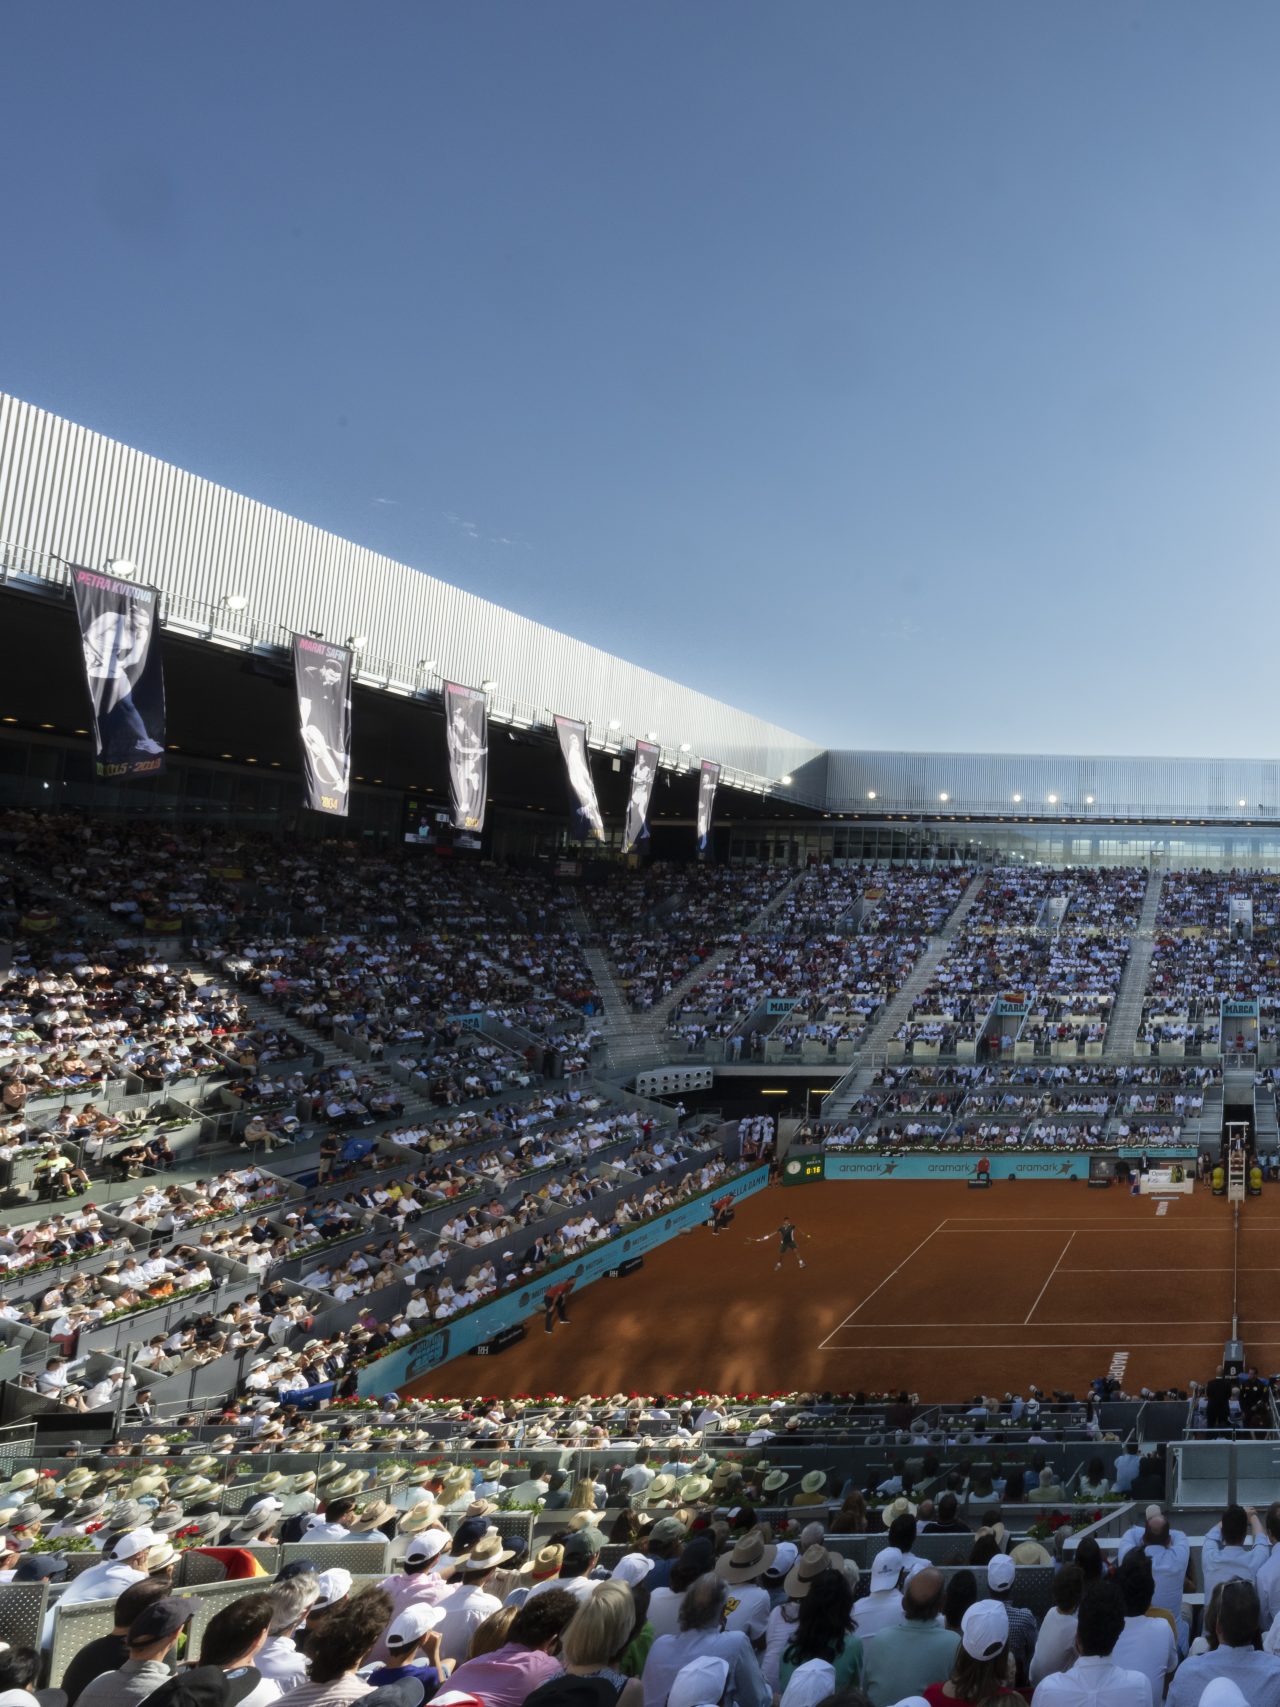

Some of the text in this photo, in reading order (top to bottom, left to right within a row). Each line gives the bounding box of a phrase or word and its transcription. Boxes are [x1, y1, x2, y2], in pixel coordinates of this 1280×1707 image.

[77, 571, 112, 591] PETRA
[299, 638, 347, 662] MARAT SAFIN
[770, 1002, 795, 1012] MARC
[1225, 1005, 1254, 1014] MARCA
[839, 1163, 881, 1172] aramark
[927, 1163, 970, 1172] aramark
[1016, 1163, 1058, 1172] aramark
[748, 1174, 766, 1191] DAMM
[1107, 1351, 1130, 1385] MADRI
